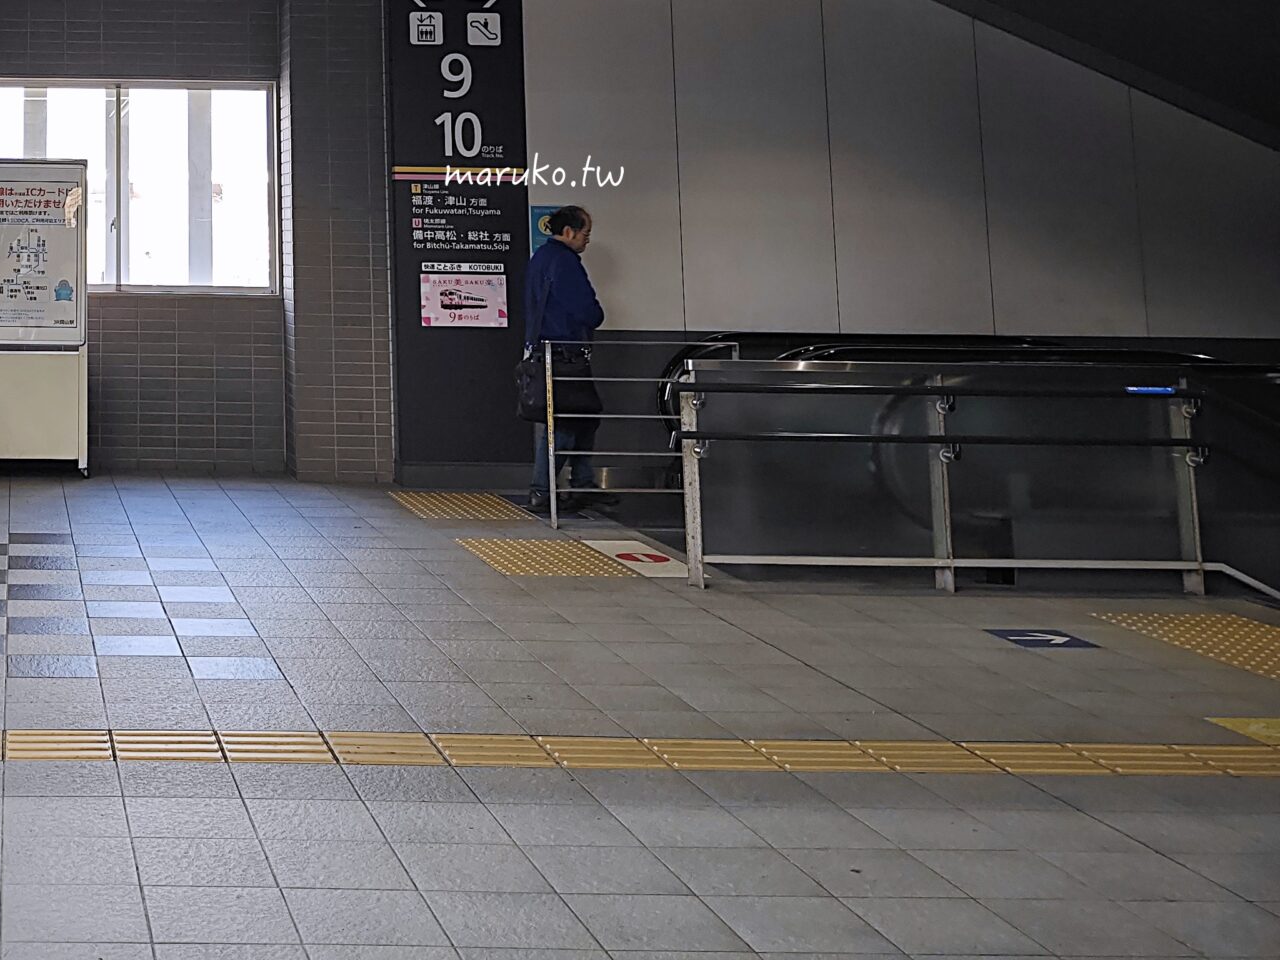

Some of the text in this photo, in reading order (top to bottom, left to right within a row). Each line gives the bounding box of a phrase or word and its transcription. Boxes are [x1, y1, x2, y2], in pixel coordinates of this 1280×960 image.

[440, 53, 472, 98] 9
[434, 112, 482, 157] 10
[482, 145, 503, 153] のりば
[468, 264, 502, 272] KOTOBUKI
